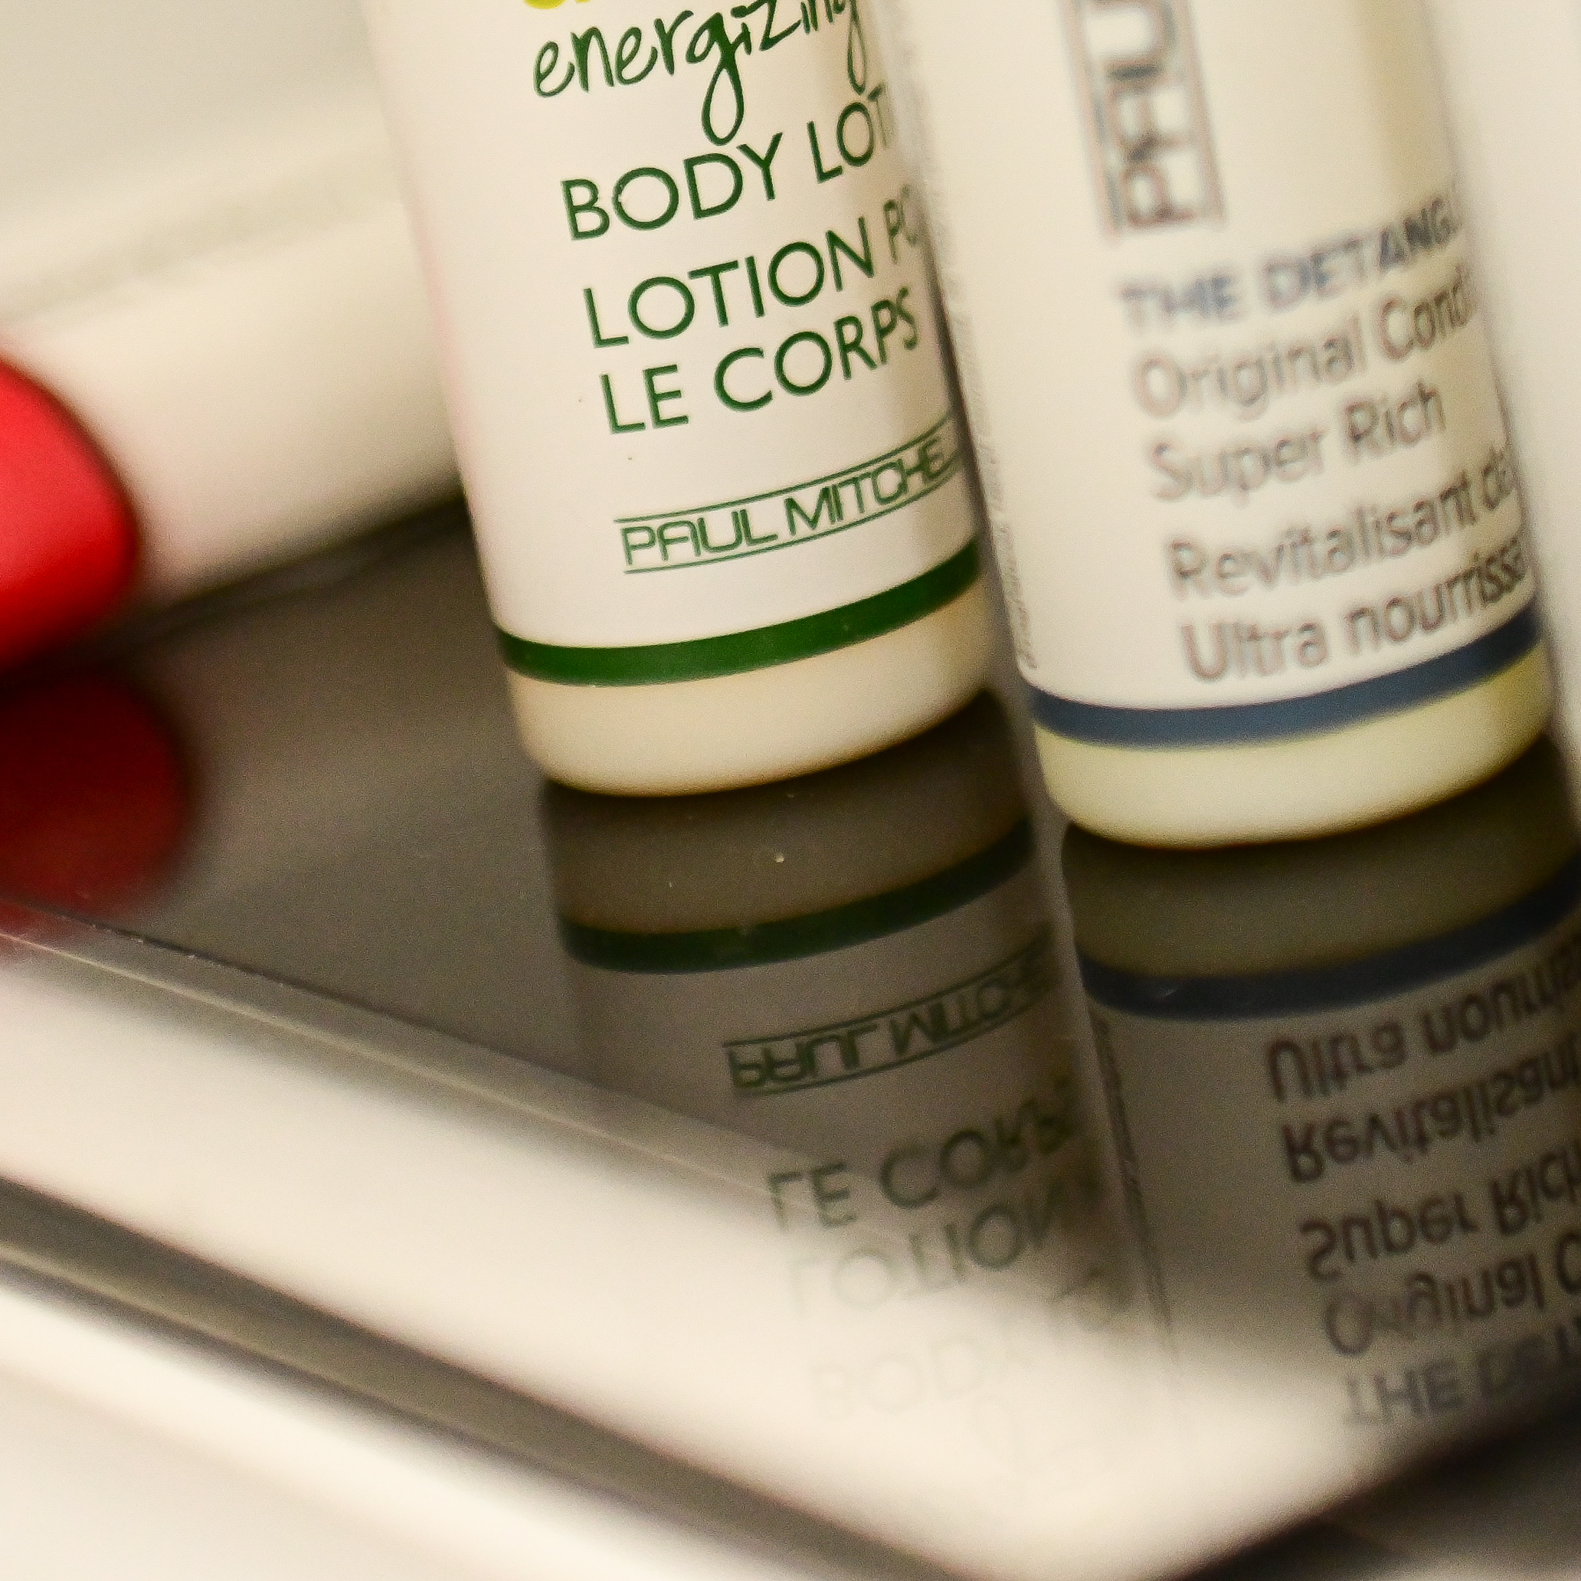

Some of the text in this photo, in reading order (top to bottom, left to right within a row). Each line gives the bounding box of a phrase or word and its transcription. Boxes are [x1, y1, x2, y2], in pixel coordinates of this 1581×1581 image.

[560, 131, 784, 242] BODY
[582, 215, 875, 350] LOTION
[1118, 265, 1241, 331] THE
[599, 285, 919, 436] LE CORPS
[1131, 315, 1369, 421] Original
[620, 437, 954, 567] PAUL MITCHE
[1148, 379, 1447, 507] Super Rich
[1169, 467, 1479, 599] Revitalisant
[1179, 612, 1330, 683] Ultra
